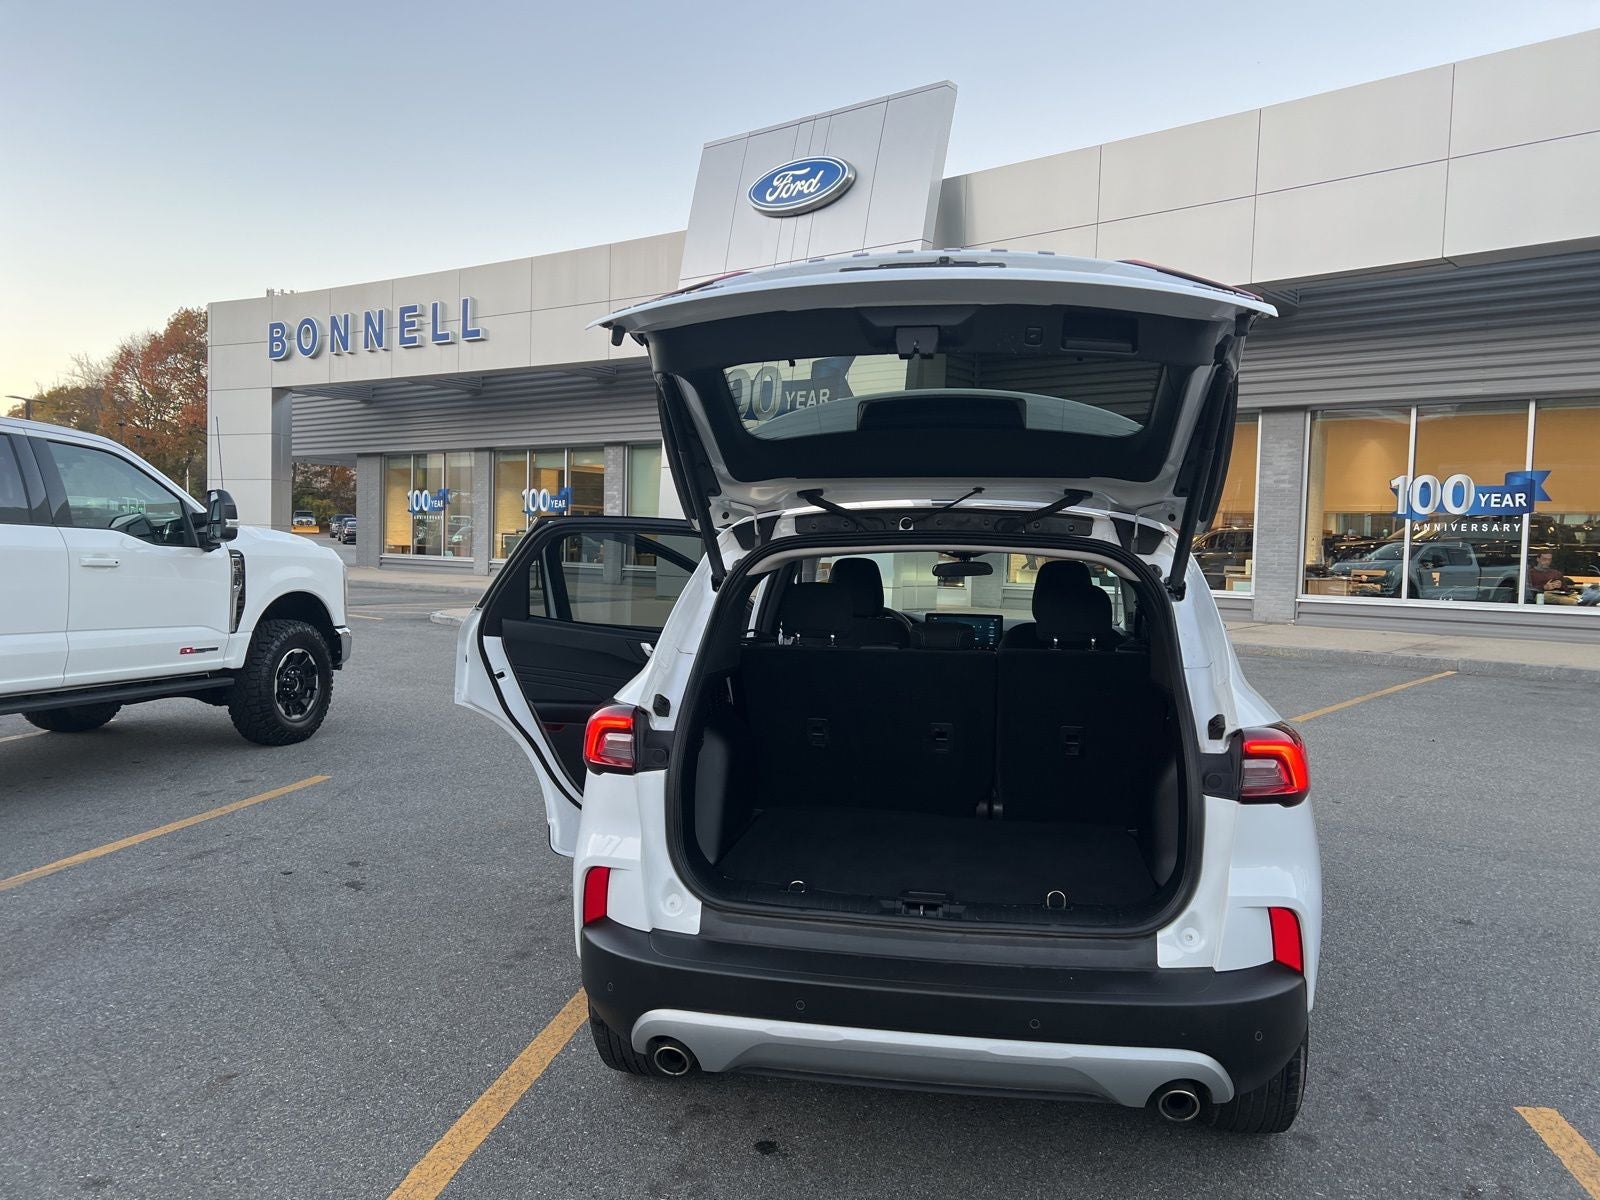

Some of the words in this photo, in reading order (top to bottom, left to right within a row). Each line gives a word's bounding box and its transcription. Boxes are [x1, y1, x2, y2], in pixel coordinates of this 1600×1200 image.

[765, 167, 825, 202] Ford
[268, 297, 485, 361] BONNELL
[784, 388, 831, 410] YEAR
[407, 489, 431, 511] 100
[521, 488, 551, 512] 100
[1389, 474, 1476, 515] 100
[1478, 492, 1528, 508] YEAR
[1412, 523, 1522, 532] ANNIVERSARY
